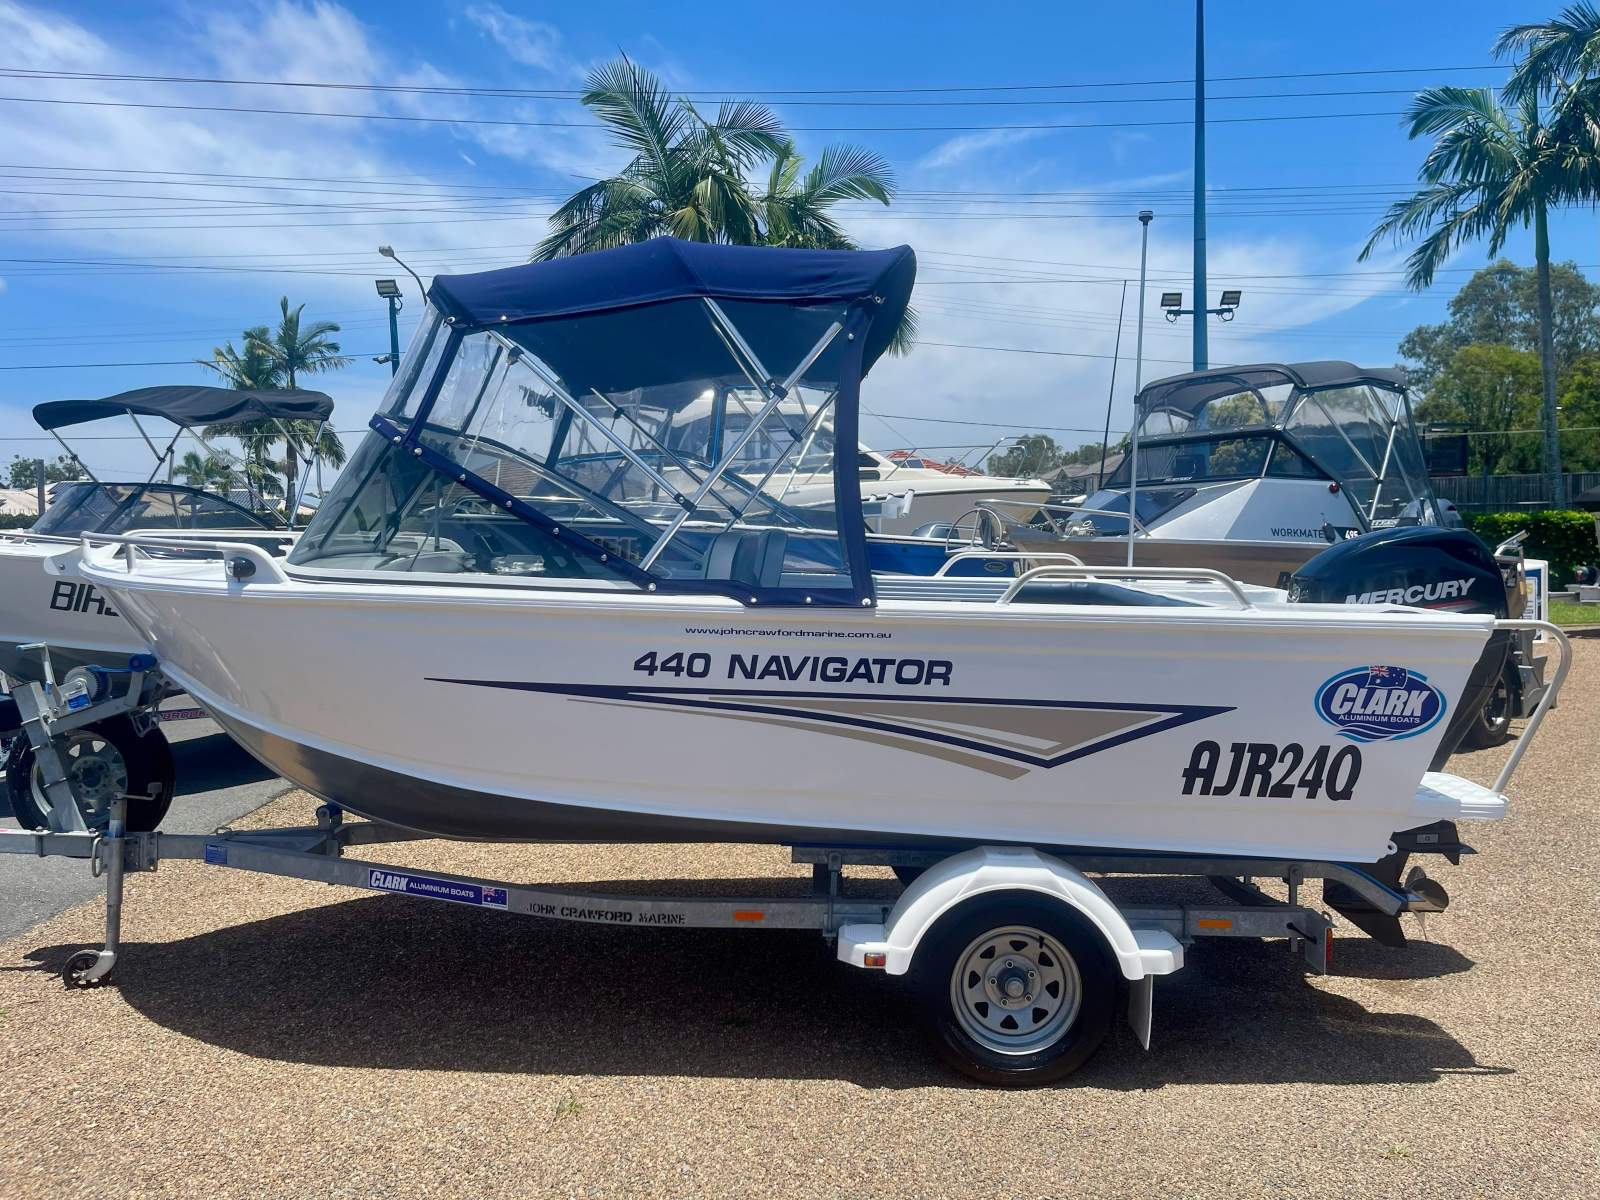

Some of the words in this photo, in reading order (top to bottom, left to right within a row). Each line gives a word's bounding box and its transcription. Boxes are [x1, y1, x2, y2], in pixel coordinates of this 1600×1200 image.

[1271, 527, 1325, 539] WORKMATE
[50, 581, 120, 617] BIR
[1345, 578, 1476, 605] MERCURY
[685, 627, 892, 639] www.johncrawfordmarine.com.au
[633, 651, 712, 678] 440
[727, 654, 954, 686] NAVIGATOR
[1330, 682, 1431, 717] CLARK
[1338, 714, 1388, 723] ALUMINIUM
[1390, 716, 1420, 724] BOATS
[1181, 740, 1362, 801] AJR24Q
[370, 871, 408, 891] CLARK
[409, 882, 450, 894] ALUMINIUM
[450, 888, 475, 898] BOATS
[527, 903, 556, 915] JOHN
[560, 906, 632, 923] CRAWFORD
[638, 912, 687, 925] MARINE
